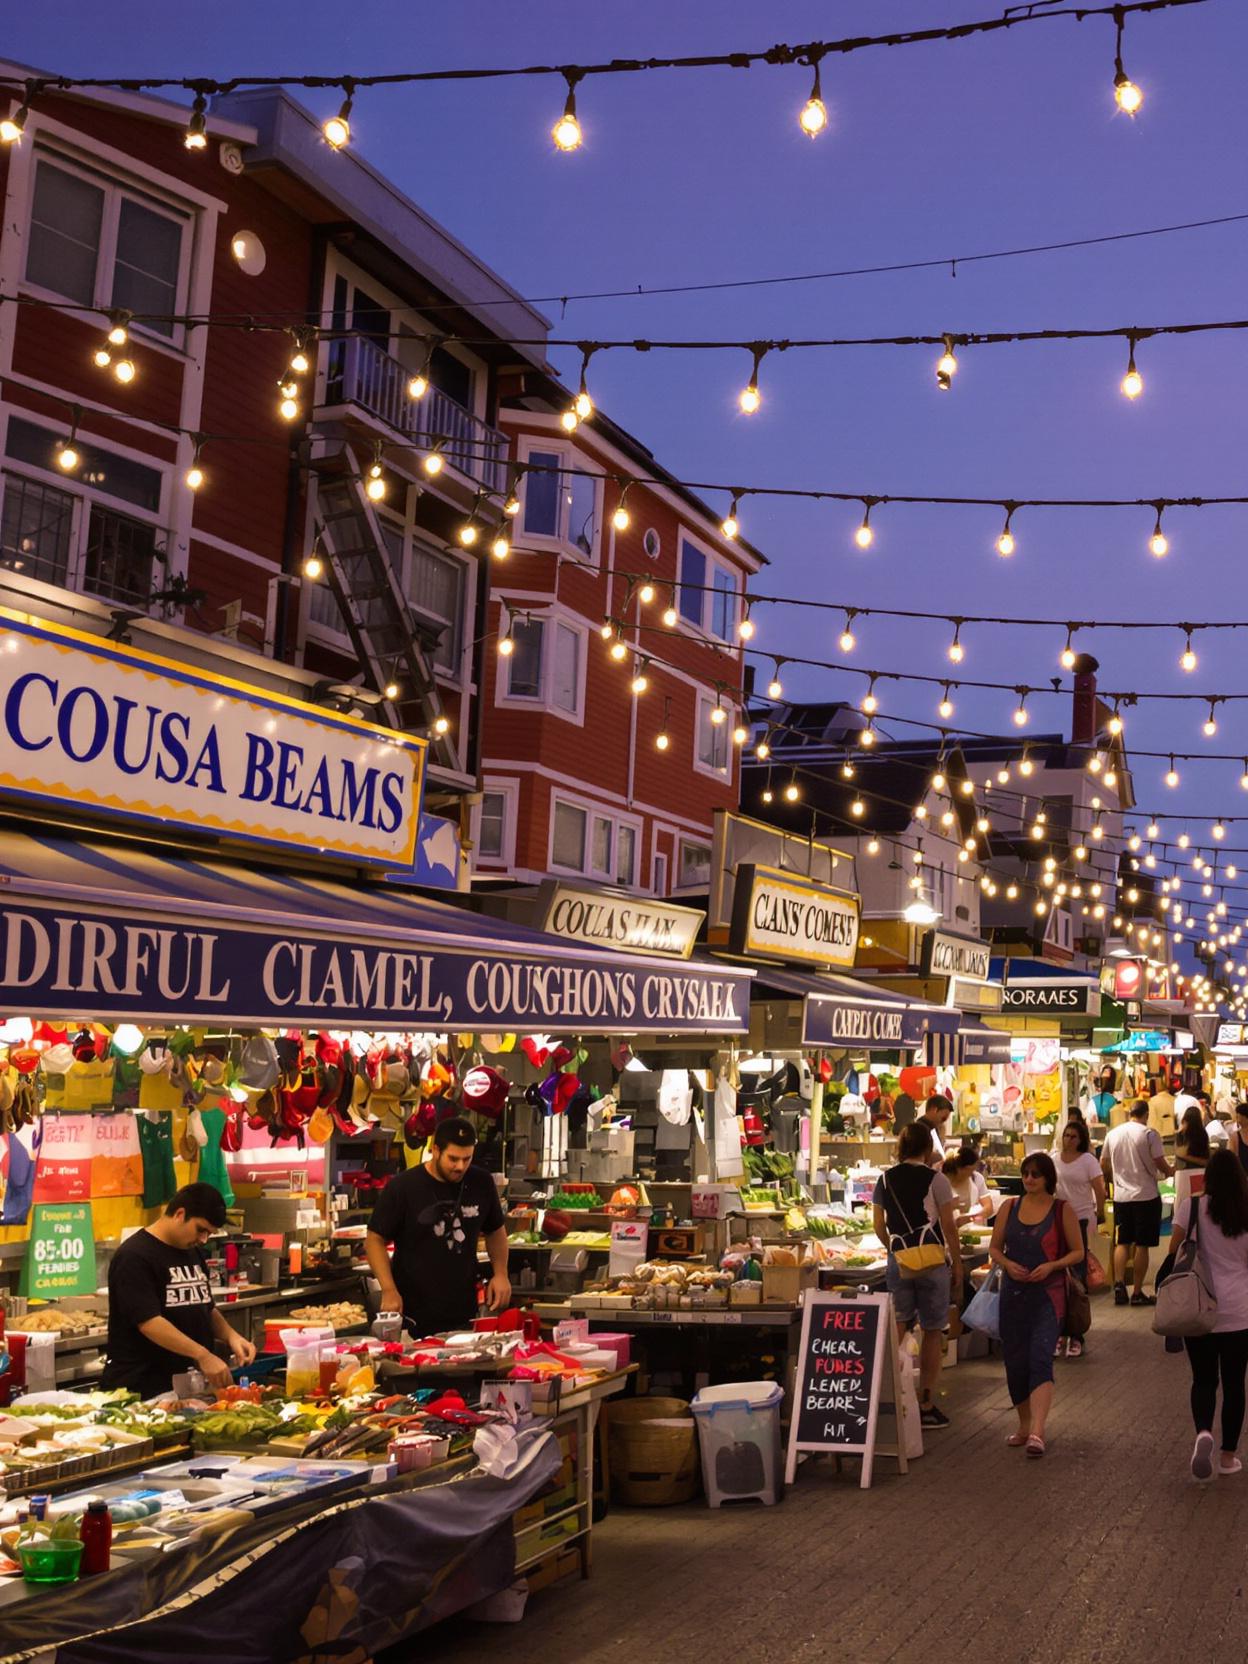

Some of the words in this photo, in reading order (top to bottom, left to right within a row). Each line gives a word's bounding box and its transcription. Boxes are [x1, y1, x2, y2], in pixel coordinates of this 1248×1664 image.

[4, 672, 227, 793] COUSA
[239, 732, 405, 834] BEAMS
[0, 911, 231, 1002] DIRFUL
[823, 1311, 865, 1331] FREE
